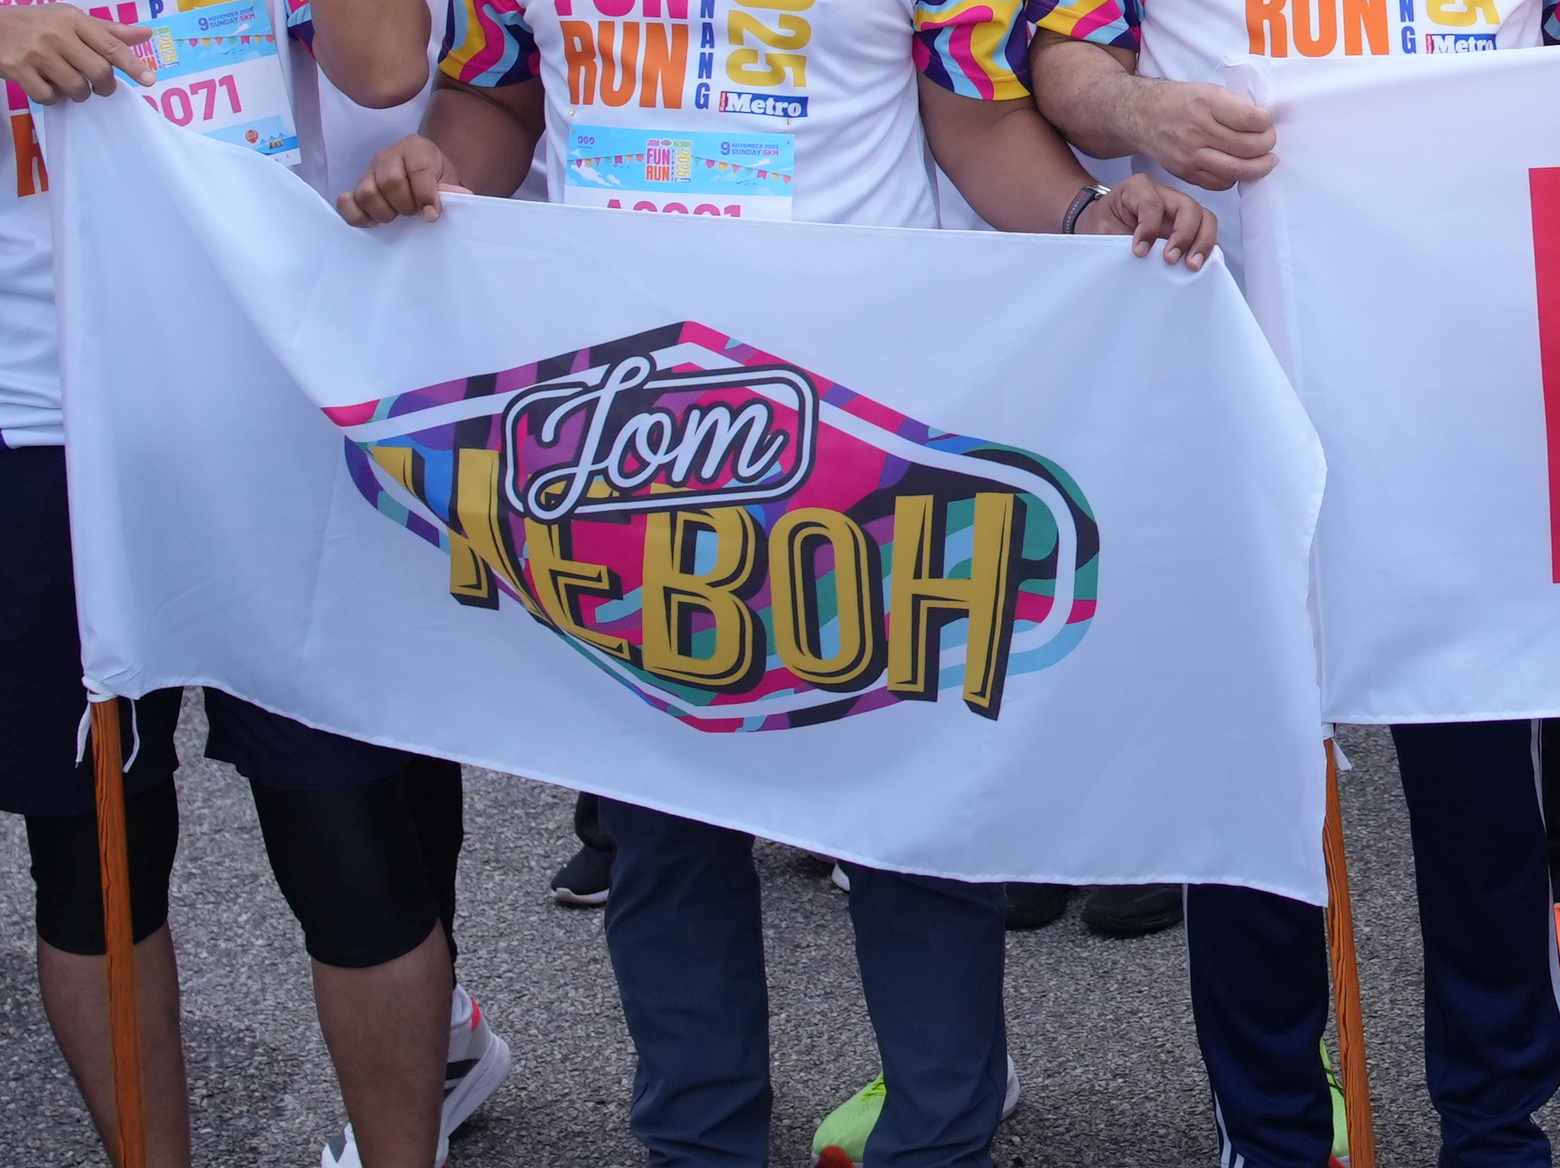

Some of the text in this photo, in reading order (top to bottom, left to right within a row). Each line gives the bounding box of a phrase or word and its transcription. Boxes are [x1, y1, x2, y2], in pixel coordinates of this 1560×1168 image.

[198, 17, 209, 31] 9
[210, 18, 238, 29] SUNDAY
[559, 20, 689, 110] RUN
[726, 93, 802, 117] Metro
[646, 147, 670, 165] FUN
[720, 141, 731, 156] 9
[646, 165, 670, 182] RUN
[529, 353, 786, 522] Jom
